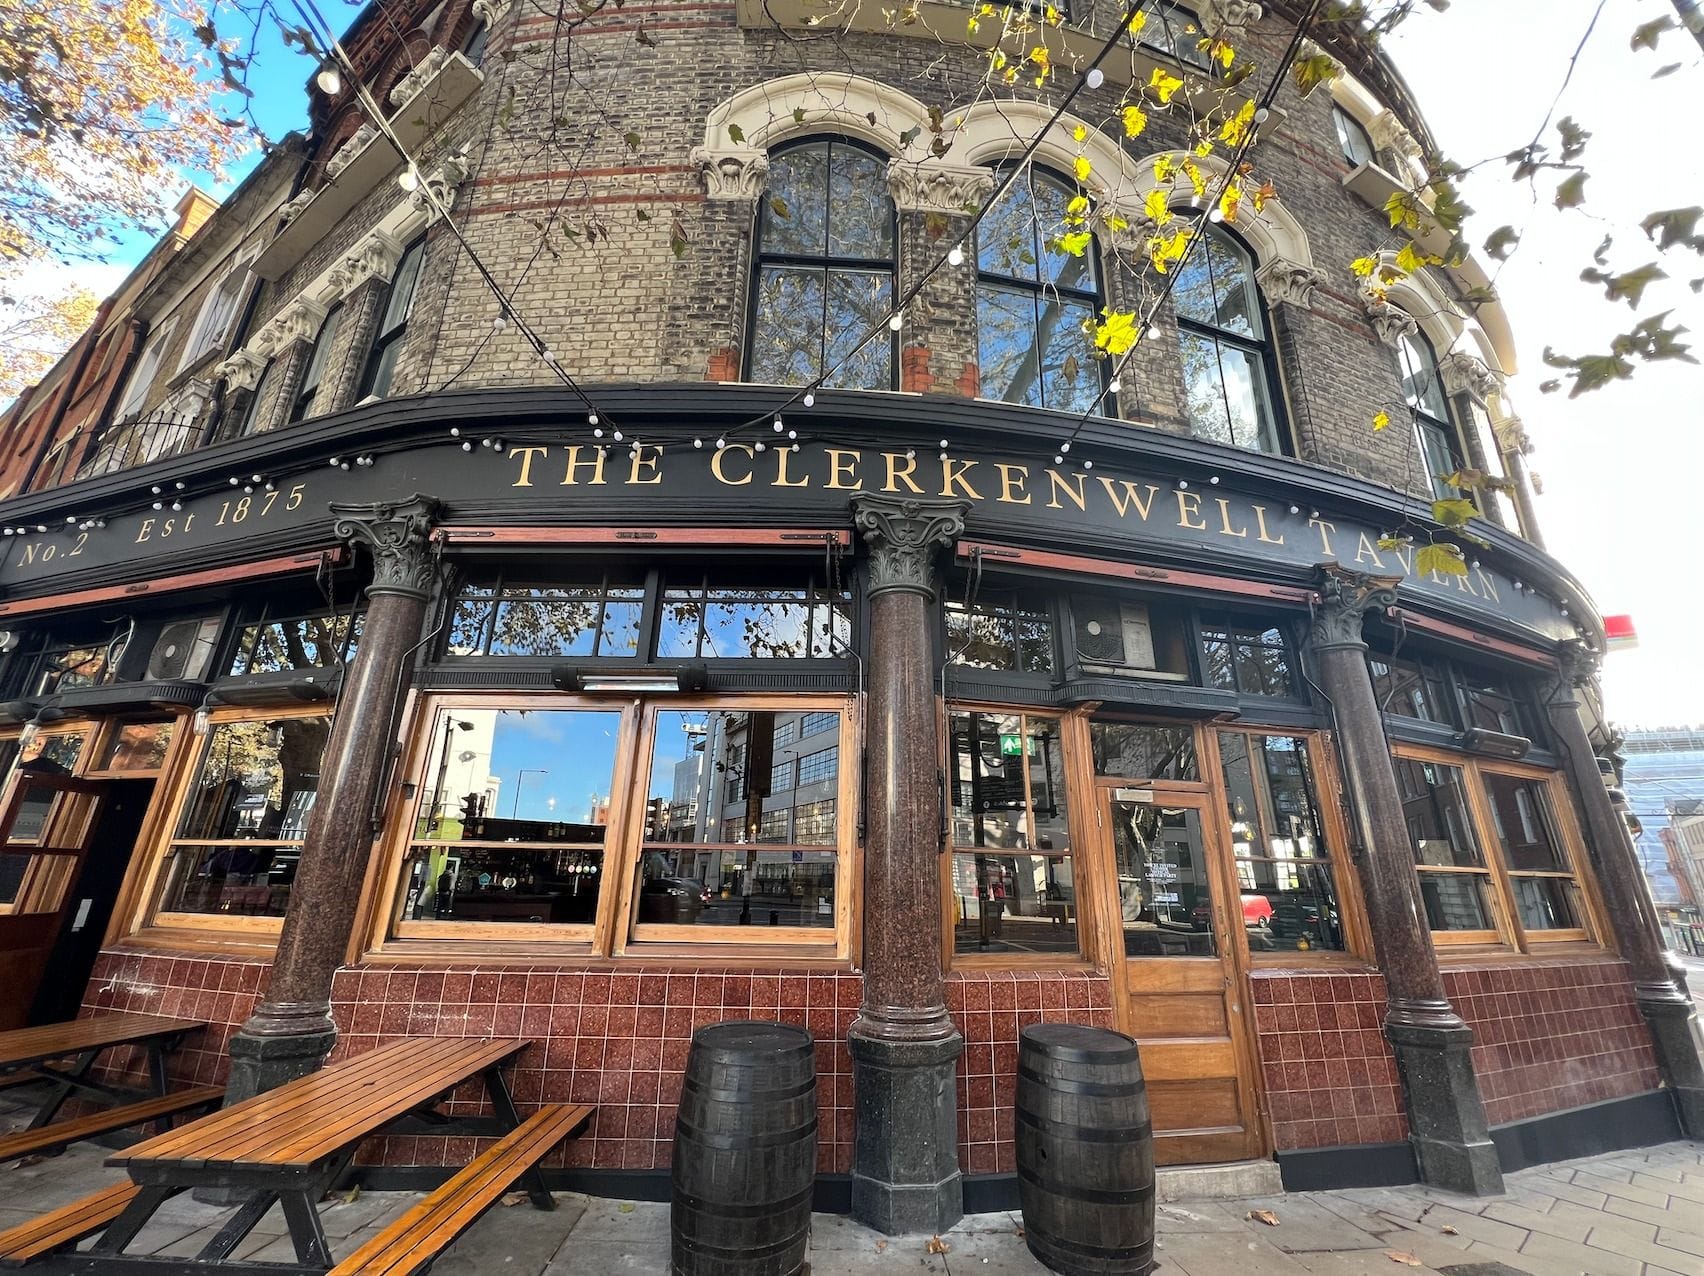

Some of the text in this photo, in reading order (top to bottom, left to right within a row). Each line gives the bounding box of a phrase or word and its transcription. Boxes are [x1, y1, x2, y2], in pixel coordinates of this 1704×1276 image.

[135, 482, 307, 544] Est 1875
[508, 445, 664, 488] THE
[710, 443, 1286, 546] CLERKENWELL
